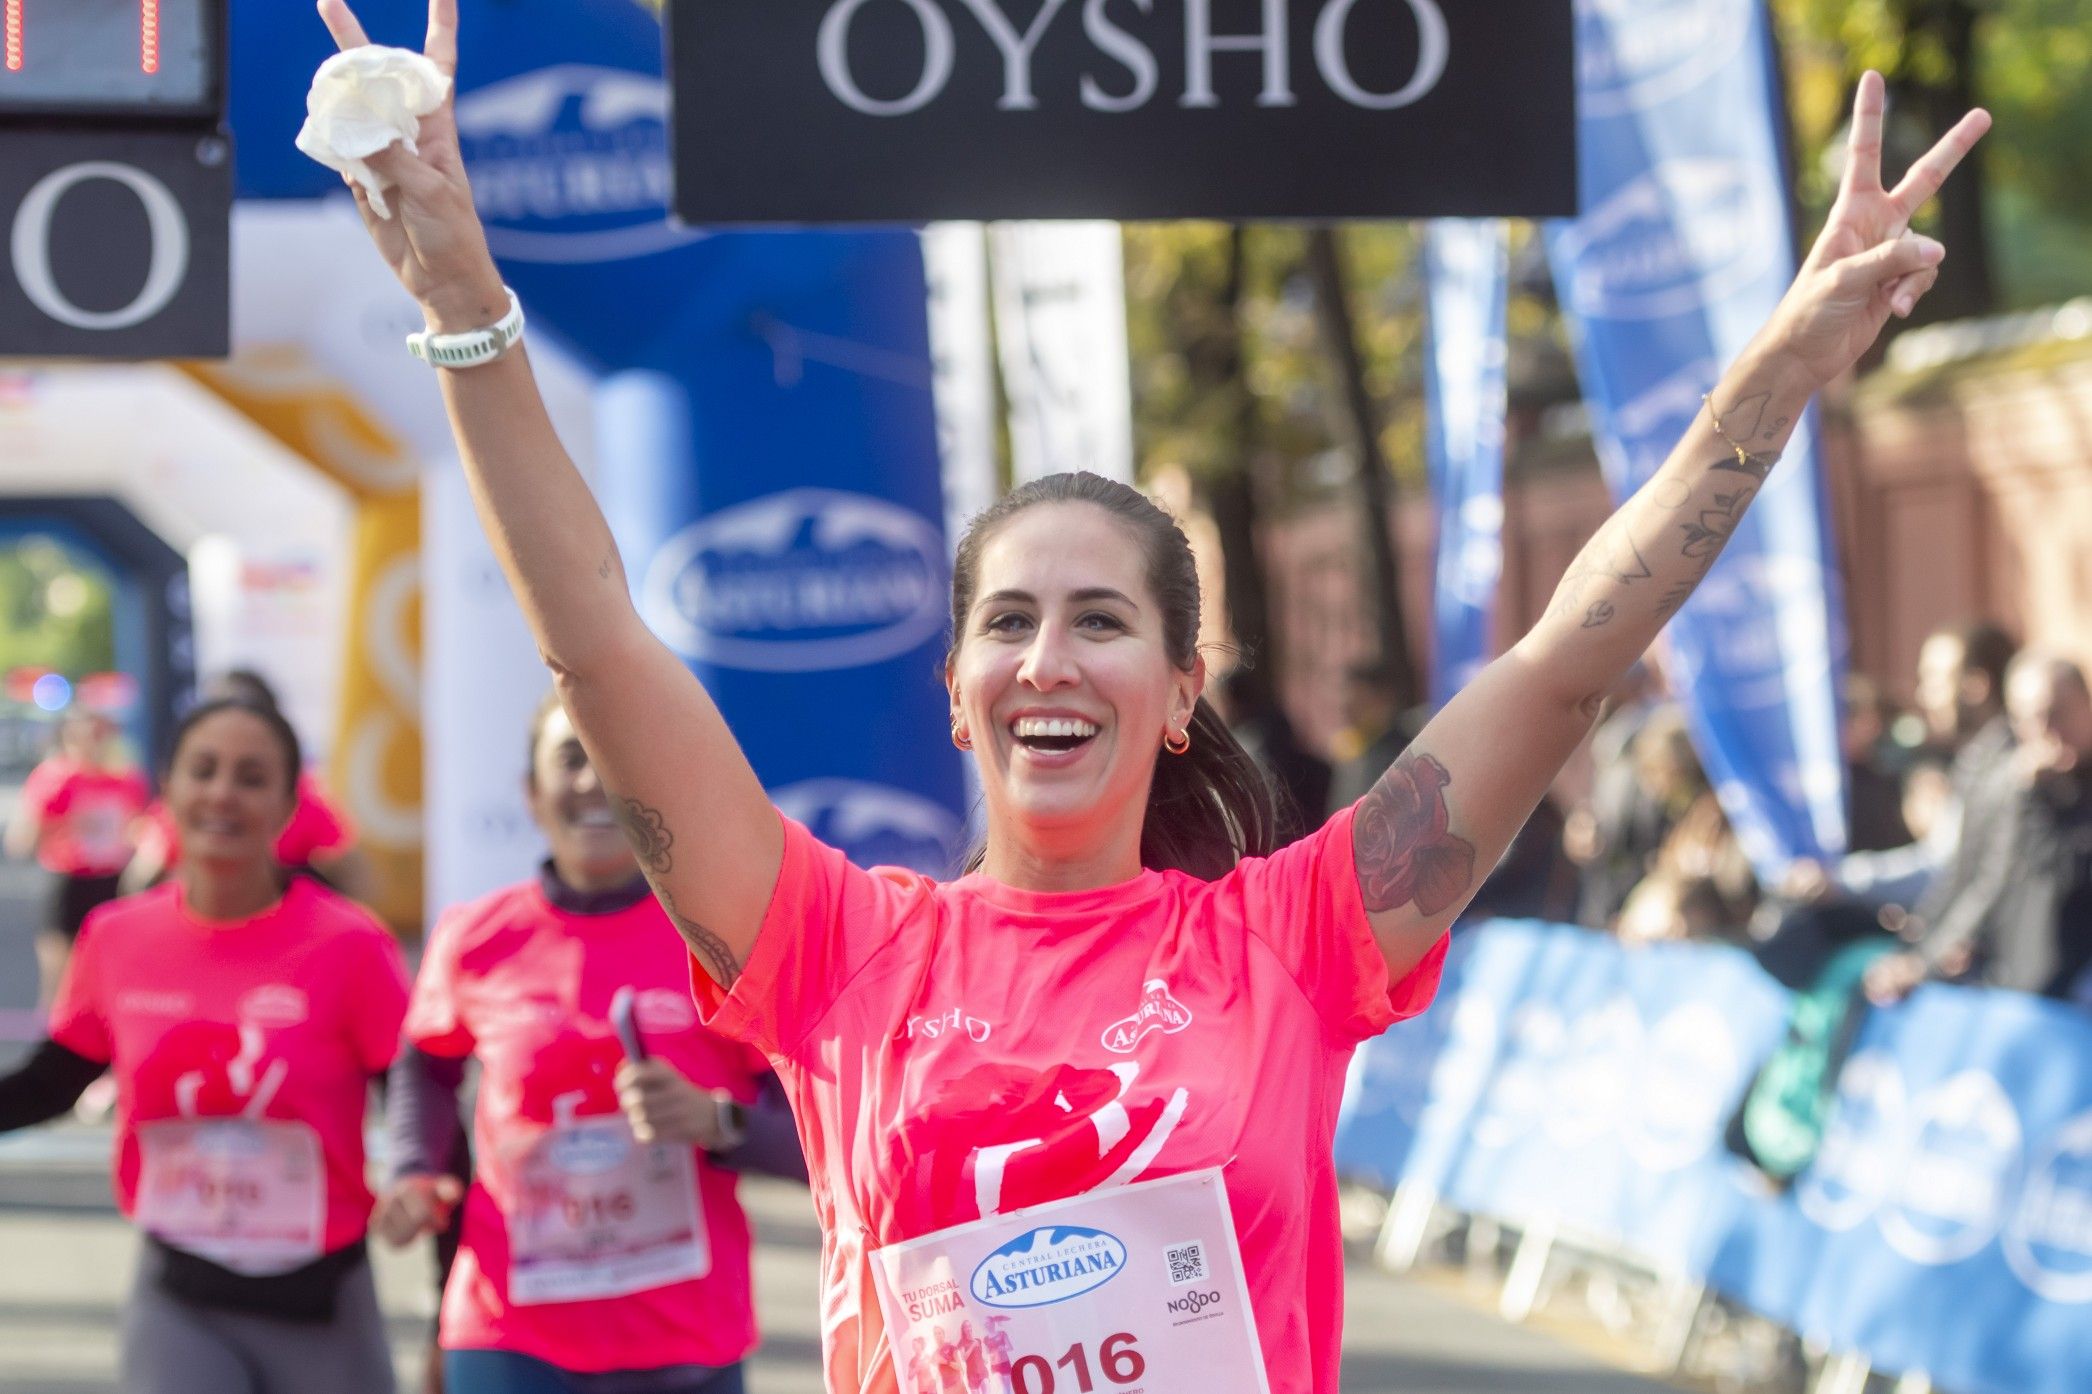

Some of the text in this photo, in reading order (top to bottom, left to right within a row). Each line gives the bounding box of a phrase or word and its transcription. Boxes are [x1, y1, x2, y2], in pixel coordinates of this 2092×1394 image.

[815, 0, 1450, 116] OYSHO
[984, 1249, 1119, 1300] ASTURIANA
[1002, 1239, 1107, 1272] CENTRAL LECHERA
[902, 1278, 960, 1303] TU DORSAL
[908, 1291, 965, 1323] SUMA
[1010, 1332, 1146, 1394] 016
